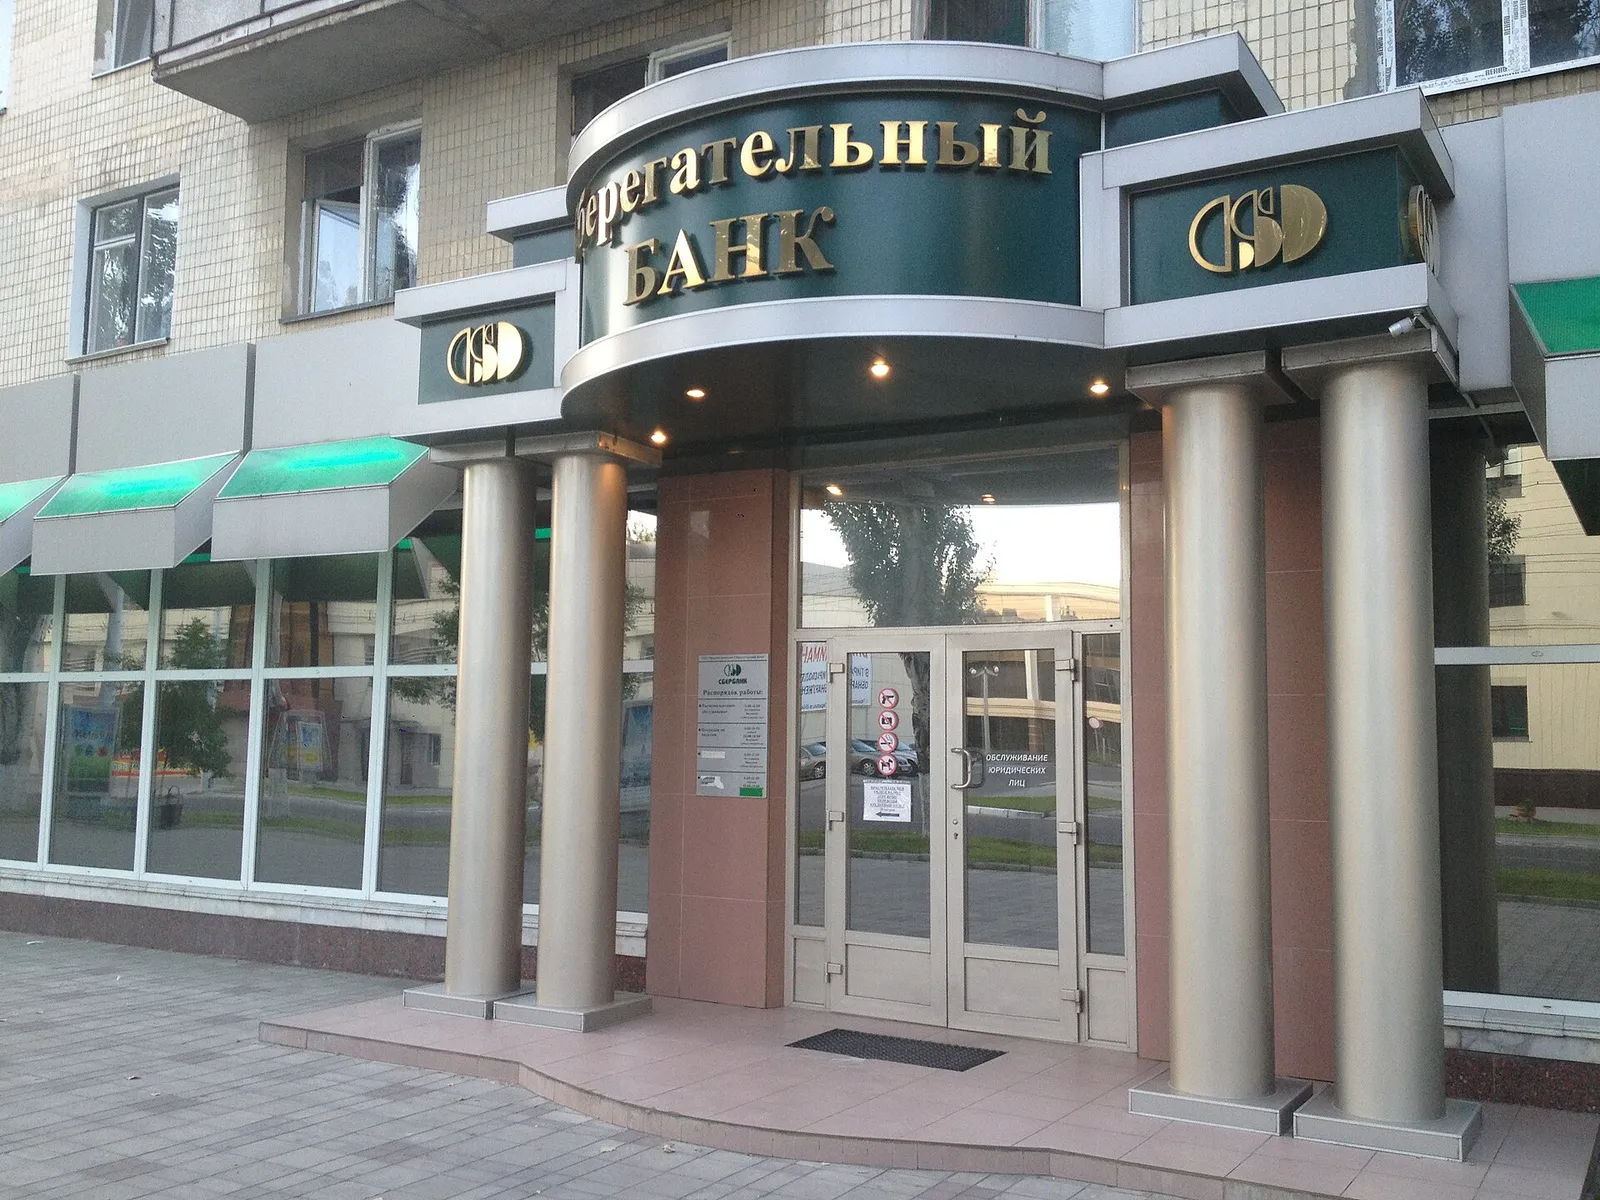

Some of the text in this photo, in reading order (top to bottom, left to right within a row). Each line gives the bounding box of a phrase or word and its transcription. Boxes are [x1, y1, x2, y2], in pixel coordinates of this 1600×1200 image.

[575, 108, 1053, 264] берегательный
[623, 206, 834, 305] БАНК
[985, 754, 1048, 762] ОБСЛУЖИВАНИЕ
[988, 767, 1046, 775] ЮРИДИЧЕСКИХ
[1008, 779, 1026, 788] ЛИЦ
